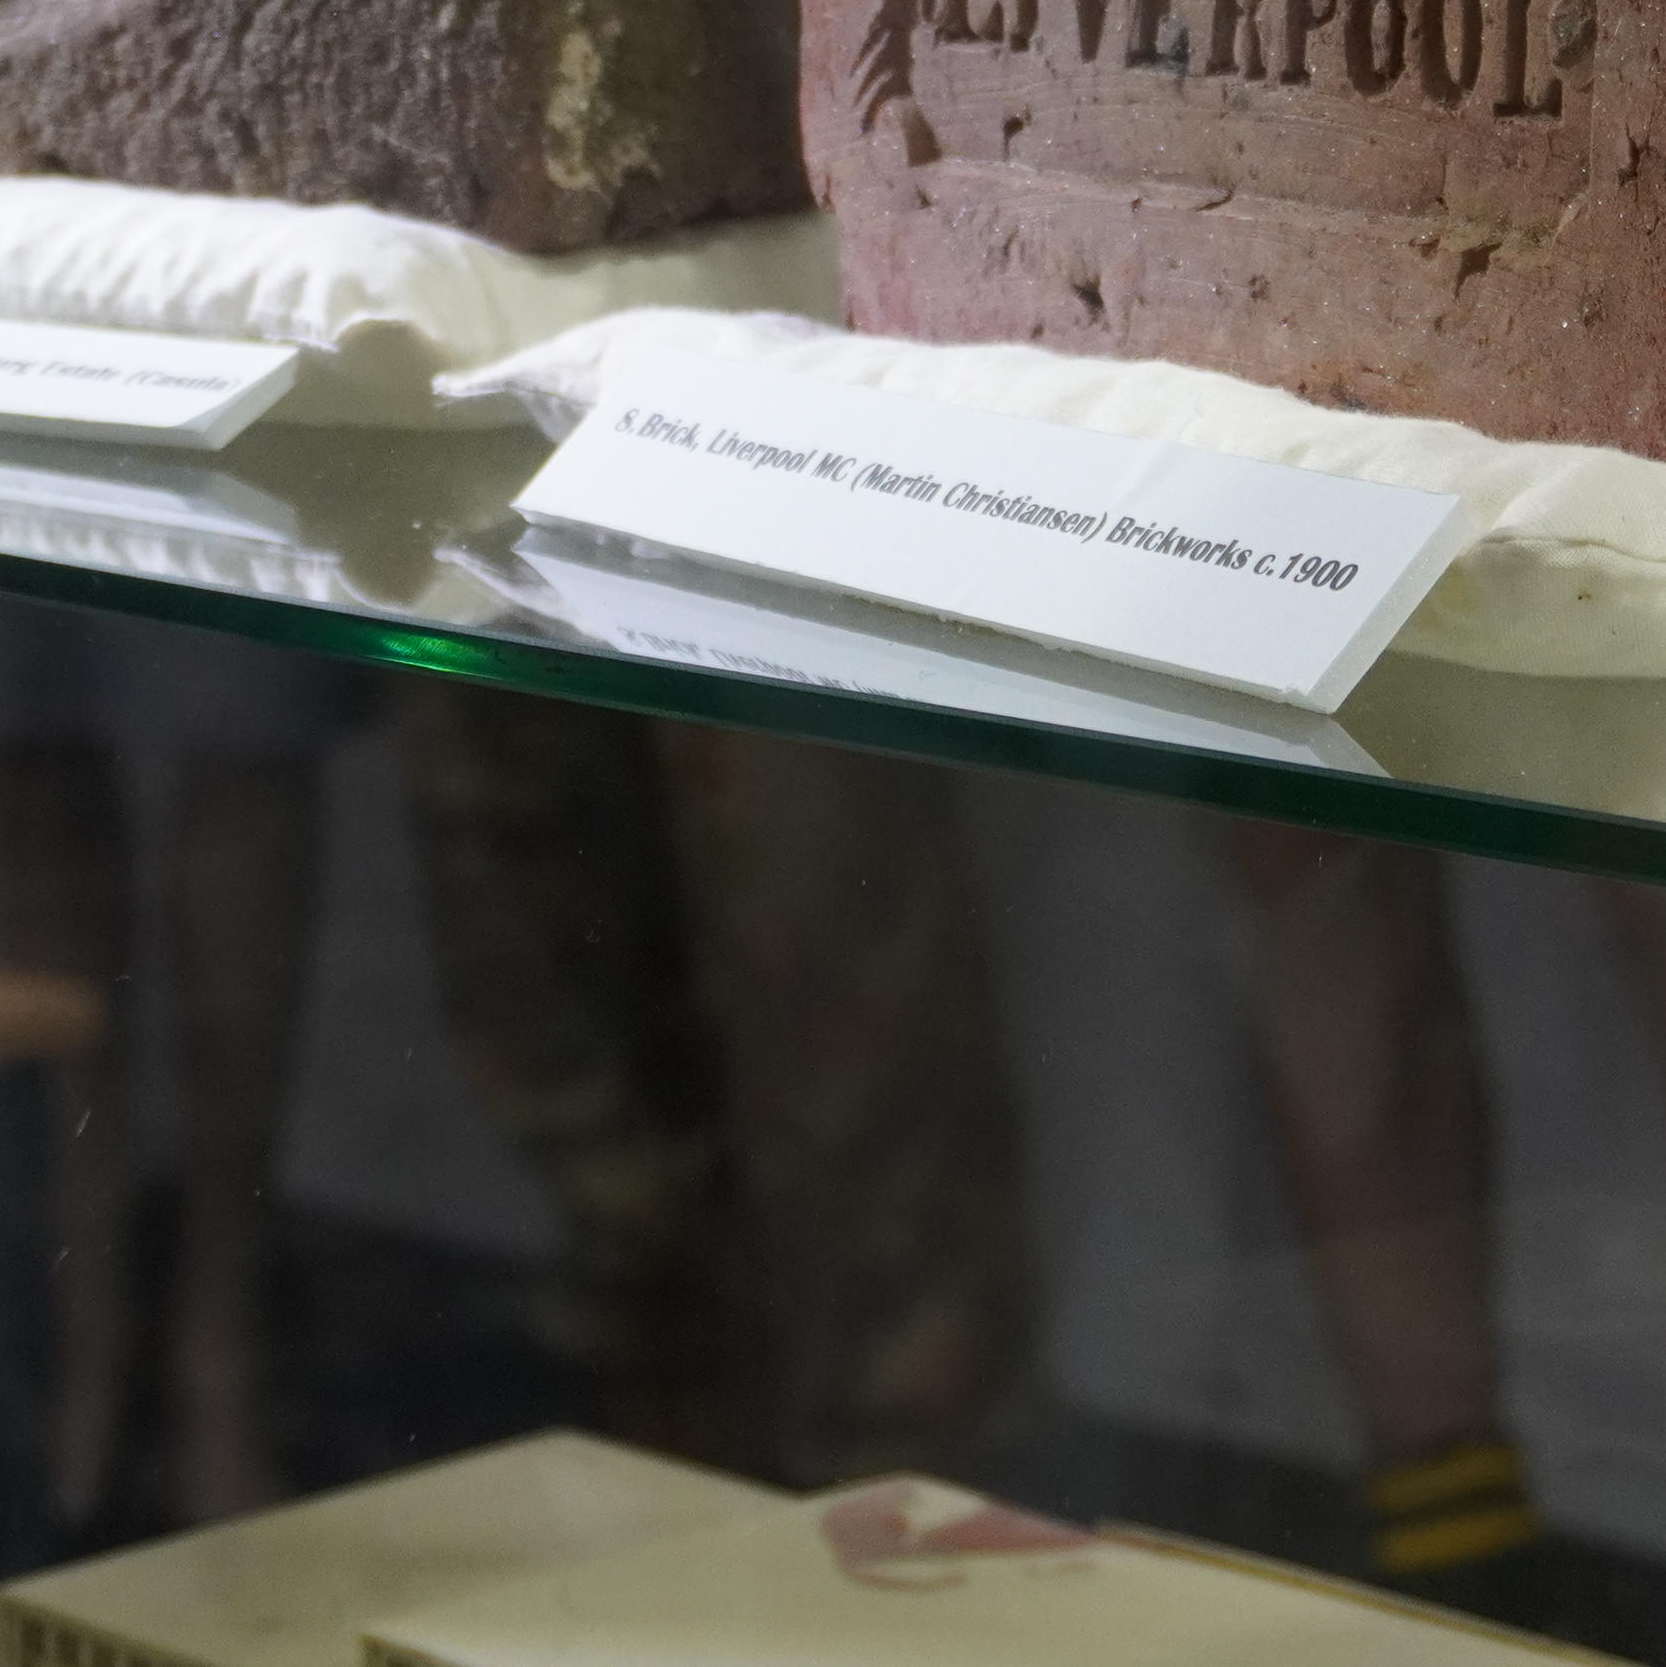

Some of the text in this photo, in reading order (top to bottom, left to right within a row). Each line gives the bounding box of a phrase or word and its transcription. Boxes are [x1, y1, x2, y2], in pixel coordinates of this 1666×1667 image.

[706, 429, 820, 471] Liverpool
[811, 451, 858, 483] MC
[850, 462, 943, 504] (Martin
[941, 481, 1109, 546] Christiansen)
[1104, 514, 1253, 571] Brickworks
